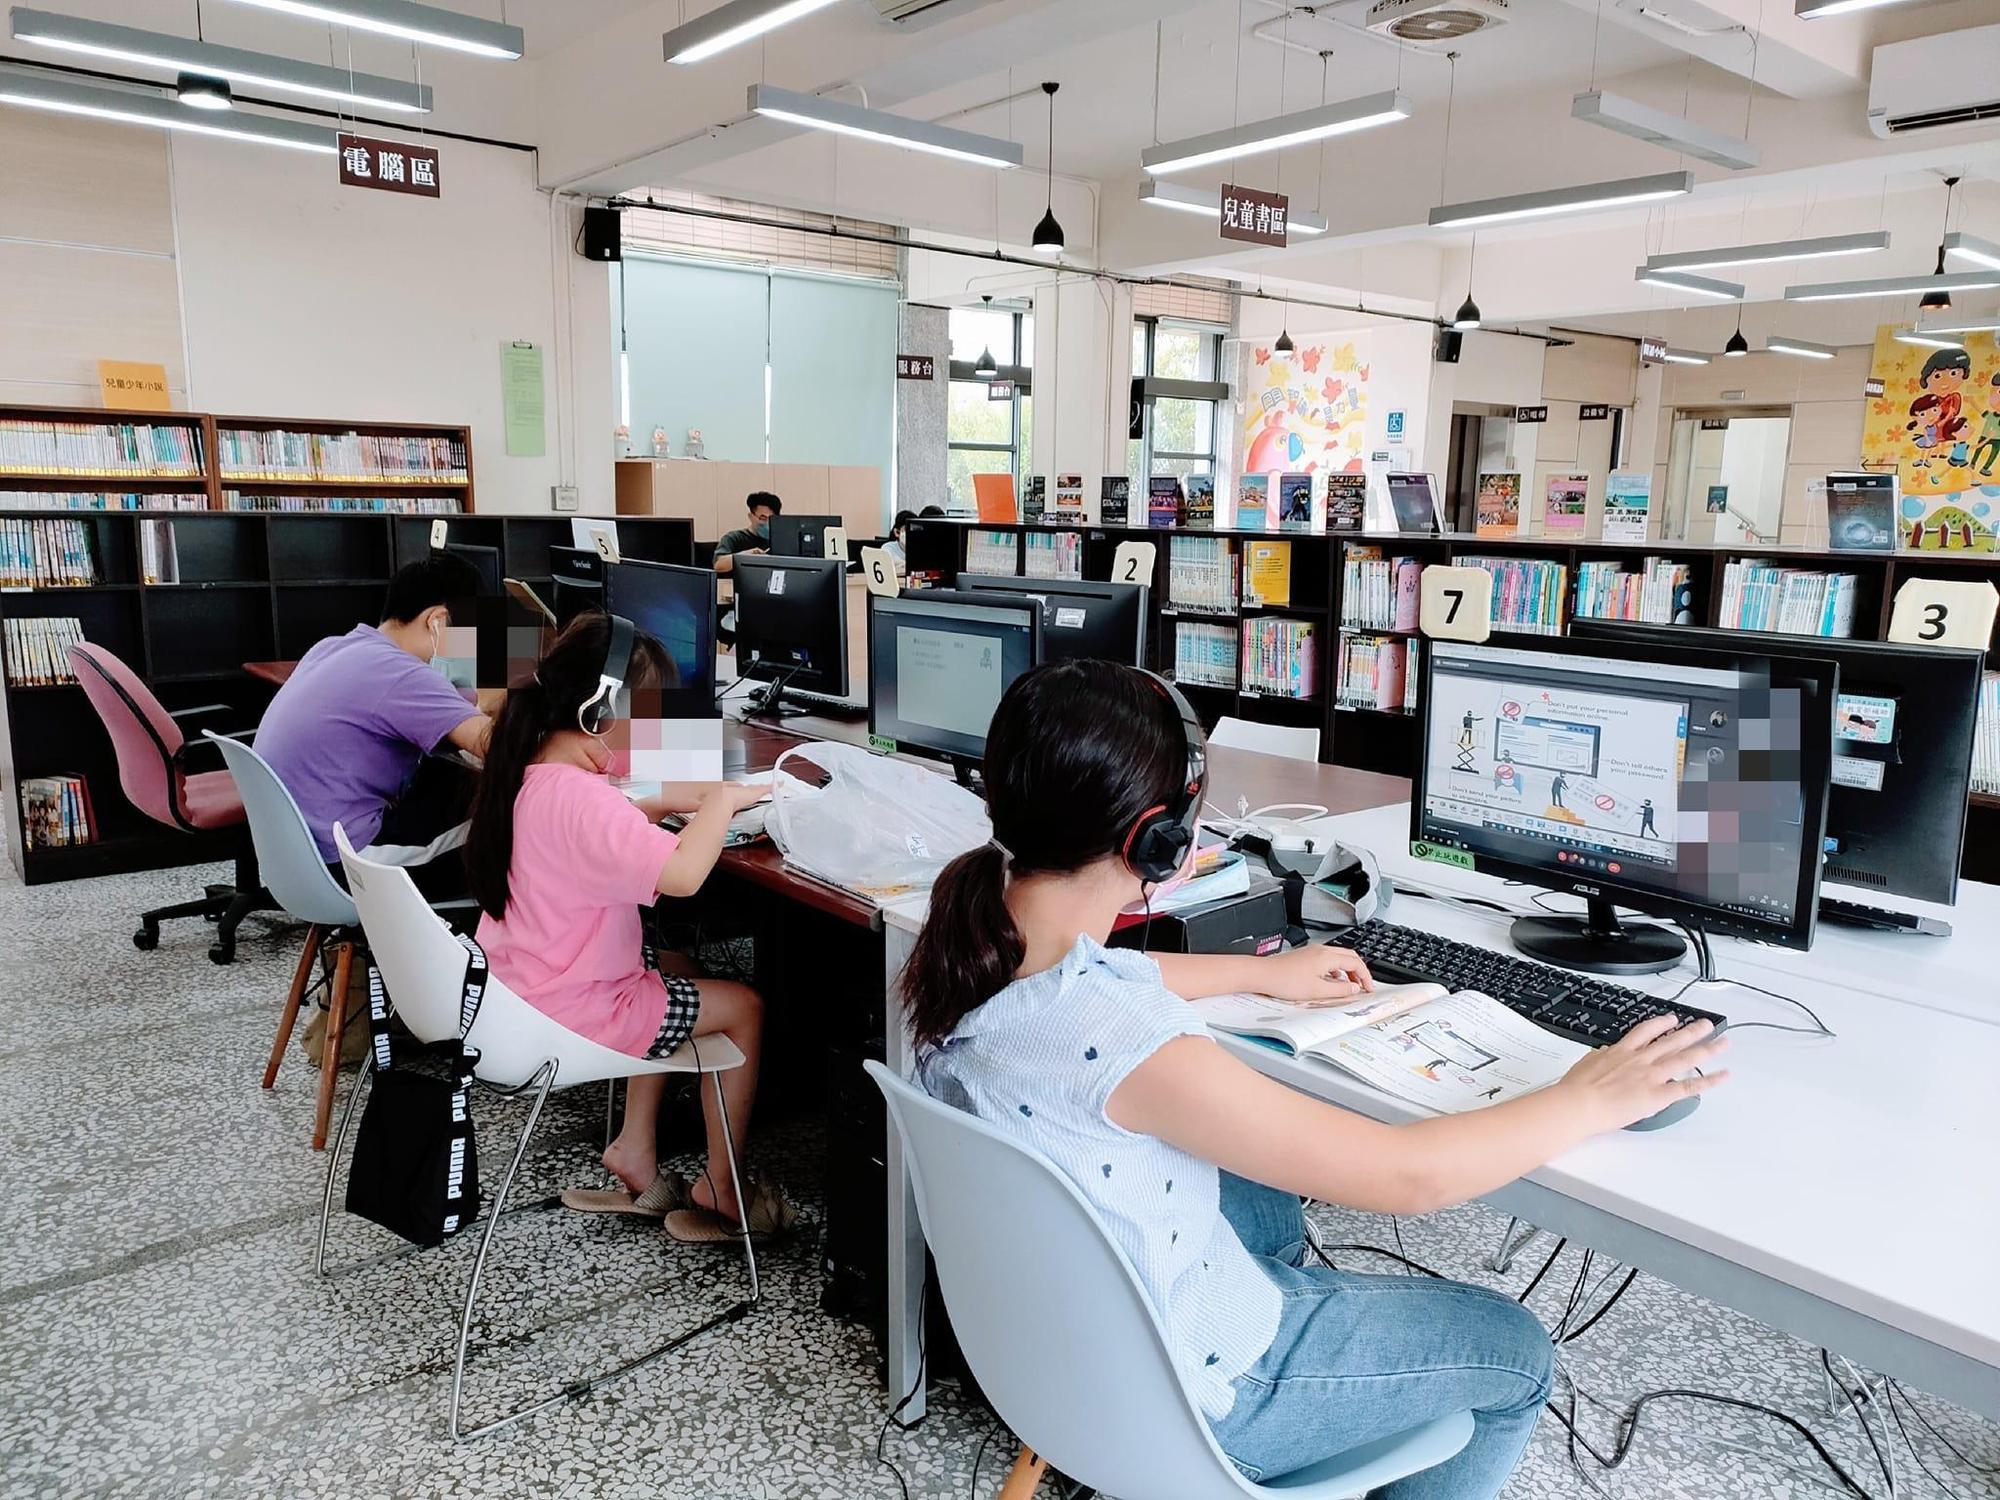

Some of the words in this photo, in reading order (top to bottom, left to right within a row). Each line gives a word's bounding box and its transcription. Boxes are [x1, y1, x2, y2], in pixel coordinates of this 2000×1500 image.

[343, 146, 436, 187] 電腦區
[1223, 196, 1286, 235] 兒童書區
[898, 360, 932, 376] 服務台
[105, 377, 165, 392] 兒童少年小說
[598, 537, 609, 555] 5
[831, 537, 838, 556] 1
[873, 561, 885, 584] 6
[1124, 557, 1138, 581] 2
[1443, 589, 1464, 625] 7
[1918, 603, 1949, 641] 3
[1573, 884, 1600, 896] ASUS
[447, 1136, 466, 1200] PUMA
